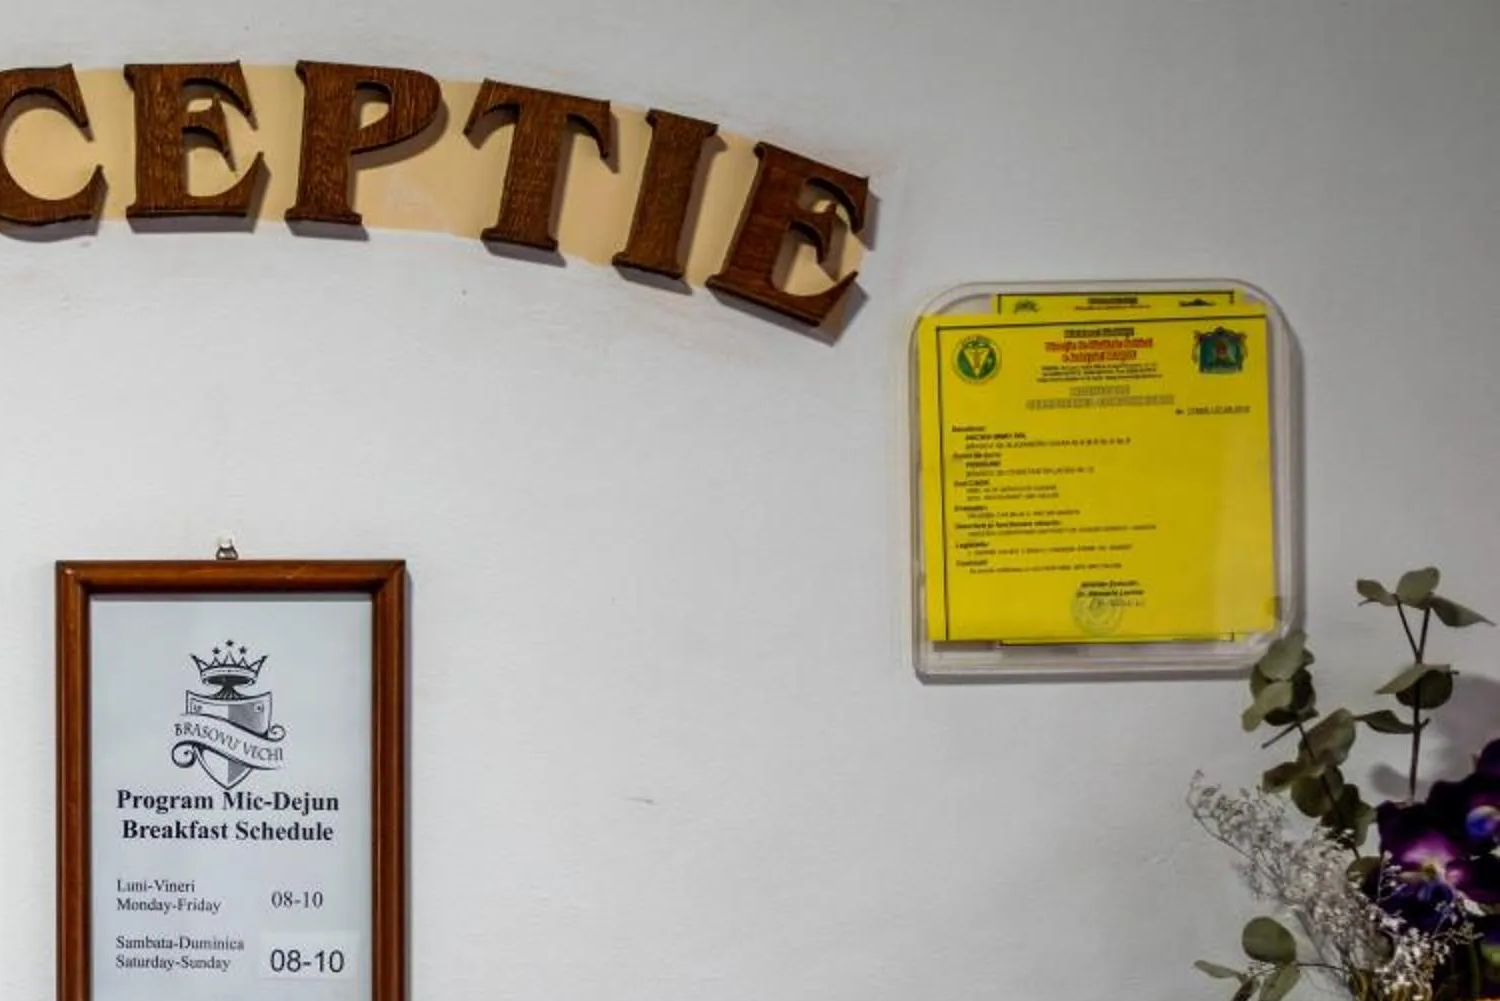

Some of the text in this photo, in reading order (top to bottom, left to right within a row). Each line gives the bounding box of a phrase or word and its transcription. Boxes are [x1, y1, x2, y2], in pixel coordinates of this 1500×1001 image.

[243, 741, 283, 761] VECHI
[116, 790, 339, 816] Program Mic-Dejun
[122, 820, 334, 842] Breakfast Schedule
[116, 879, 196, 894] Luni-Vineri
[116, 890, 324, 914] Monday-Friday 08-10
[116, 936, 244, 951] Sambata-Duminica
[116, 949, 345, 974] Saturday-Sunday 08-10
